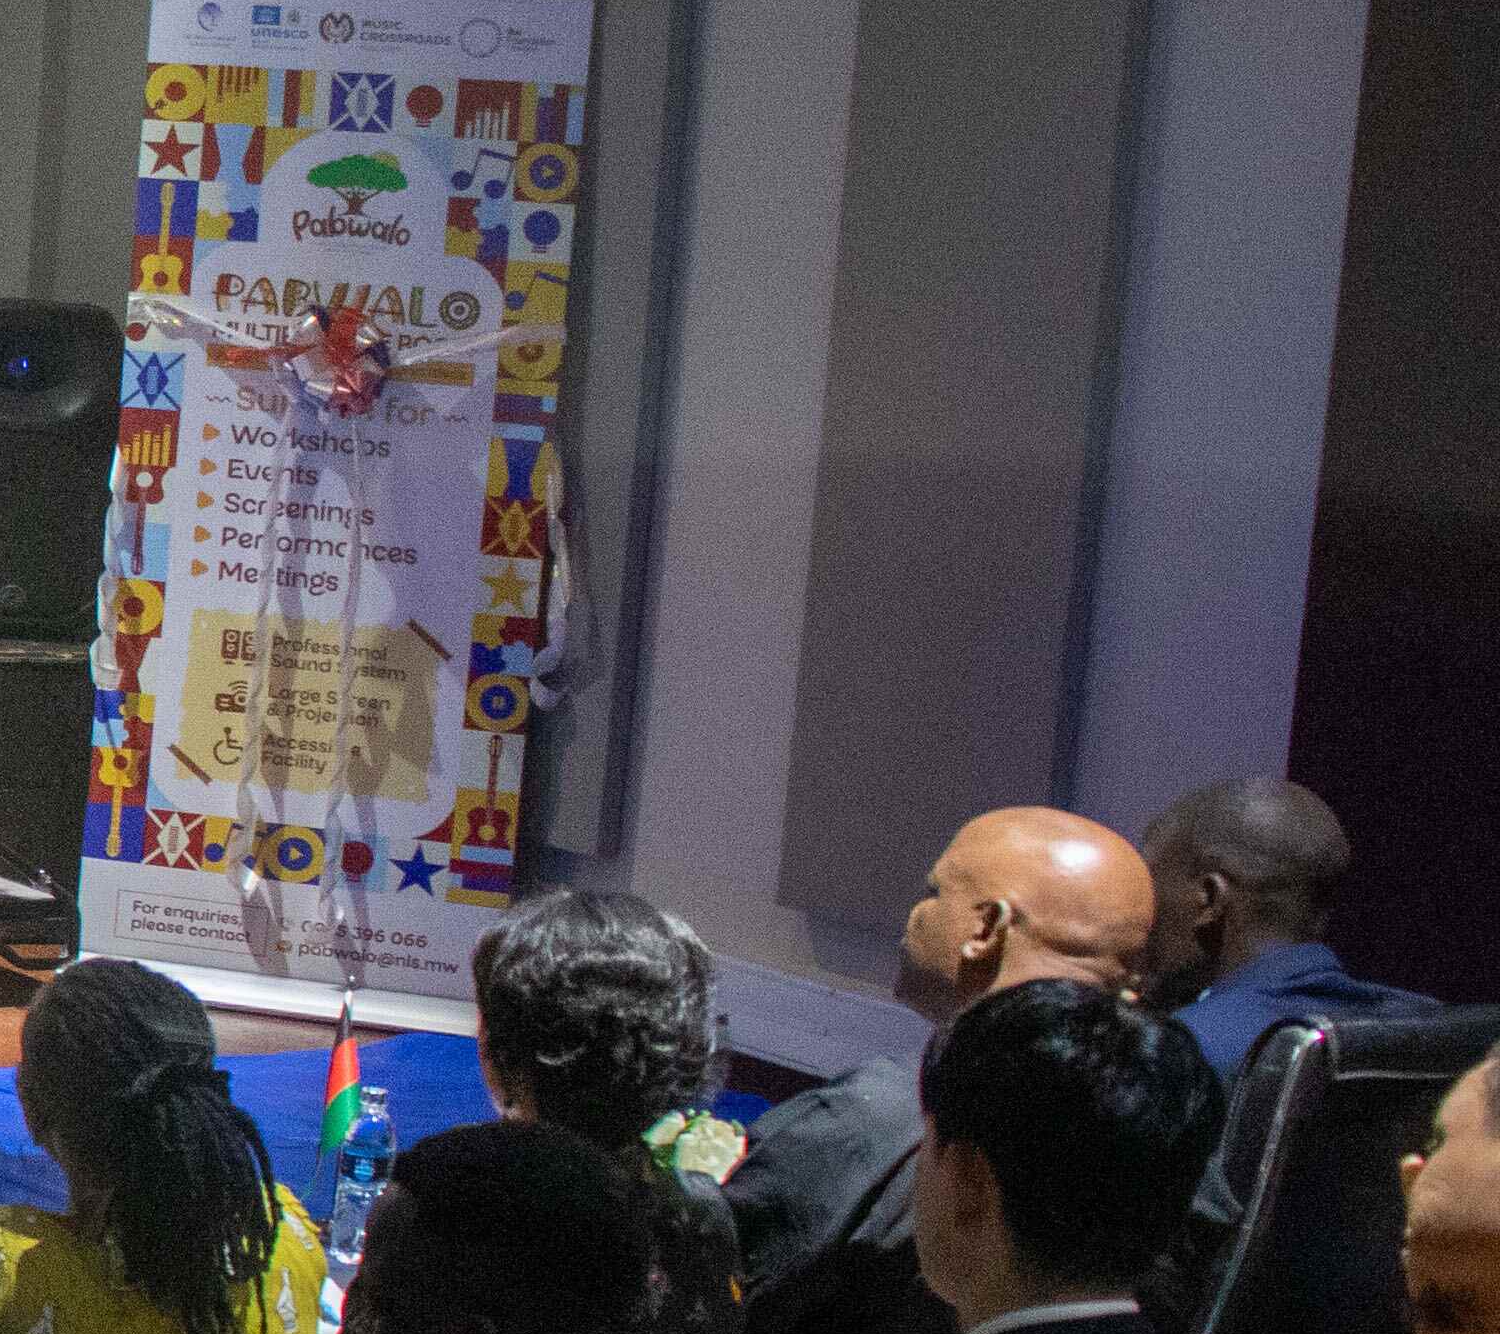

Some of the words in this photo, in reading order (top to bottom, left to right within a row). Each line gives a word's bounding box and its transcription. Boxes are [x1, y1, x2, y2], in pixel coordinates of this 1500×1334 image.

[218, 561, 339, 596] Metings
[271, 654, 331, 673] Sound
[268, 685, 320, 705] Large
[261, 751, 327, 774] Facility
[133, 900, 160, 914] For
[131, 917, 185, 934] please
[188, 926, 252, 944] contact
[391, 932, 428, 948] 066
